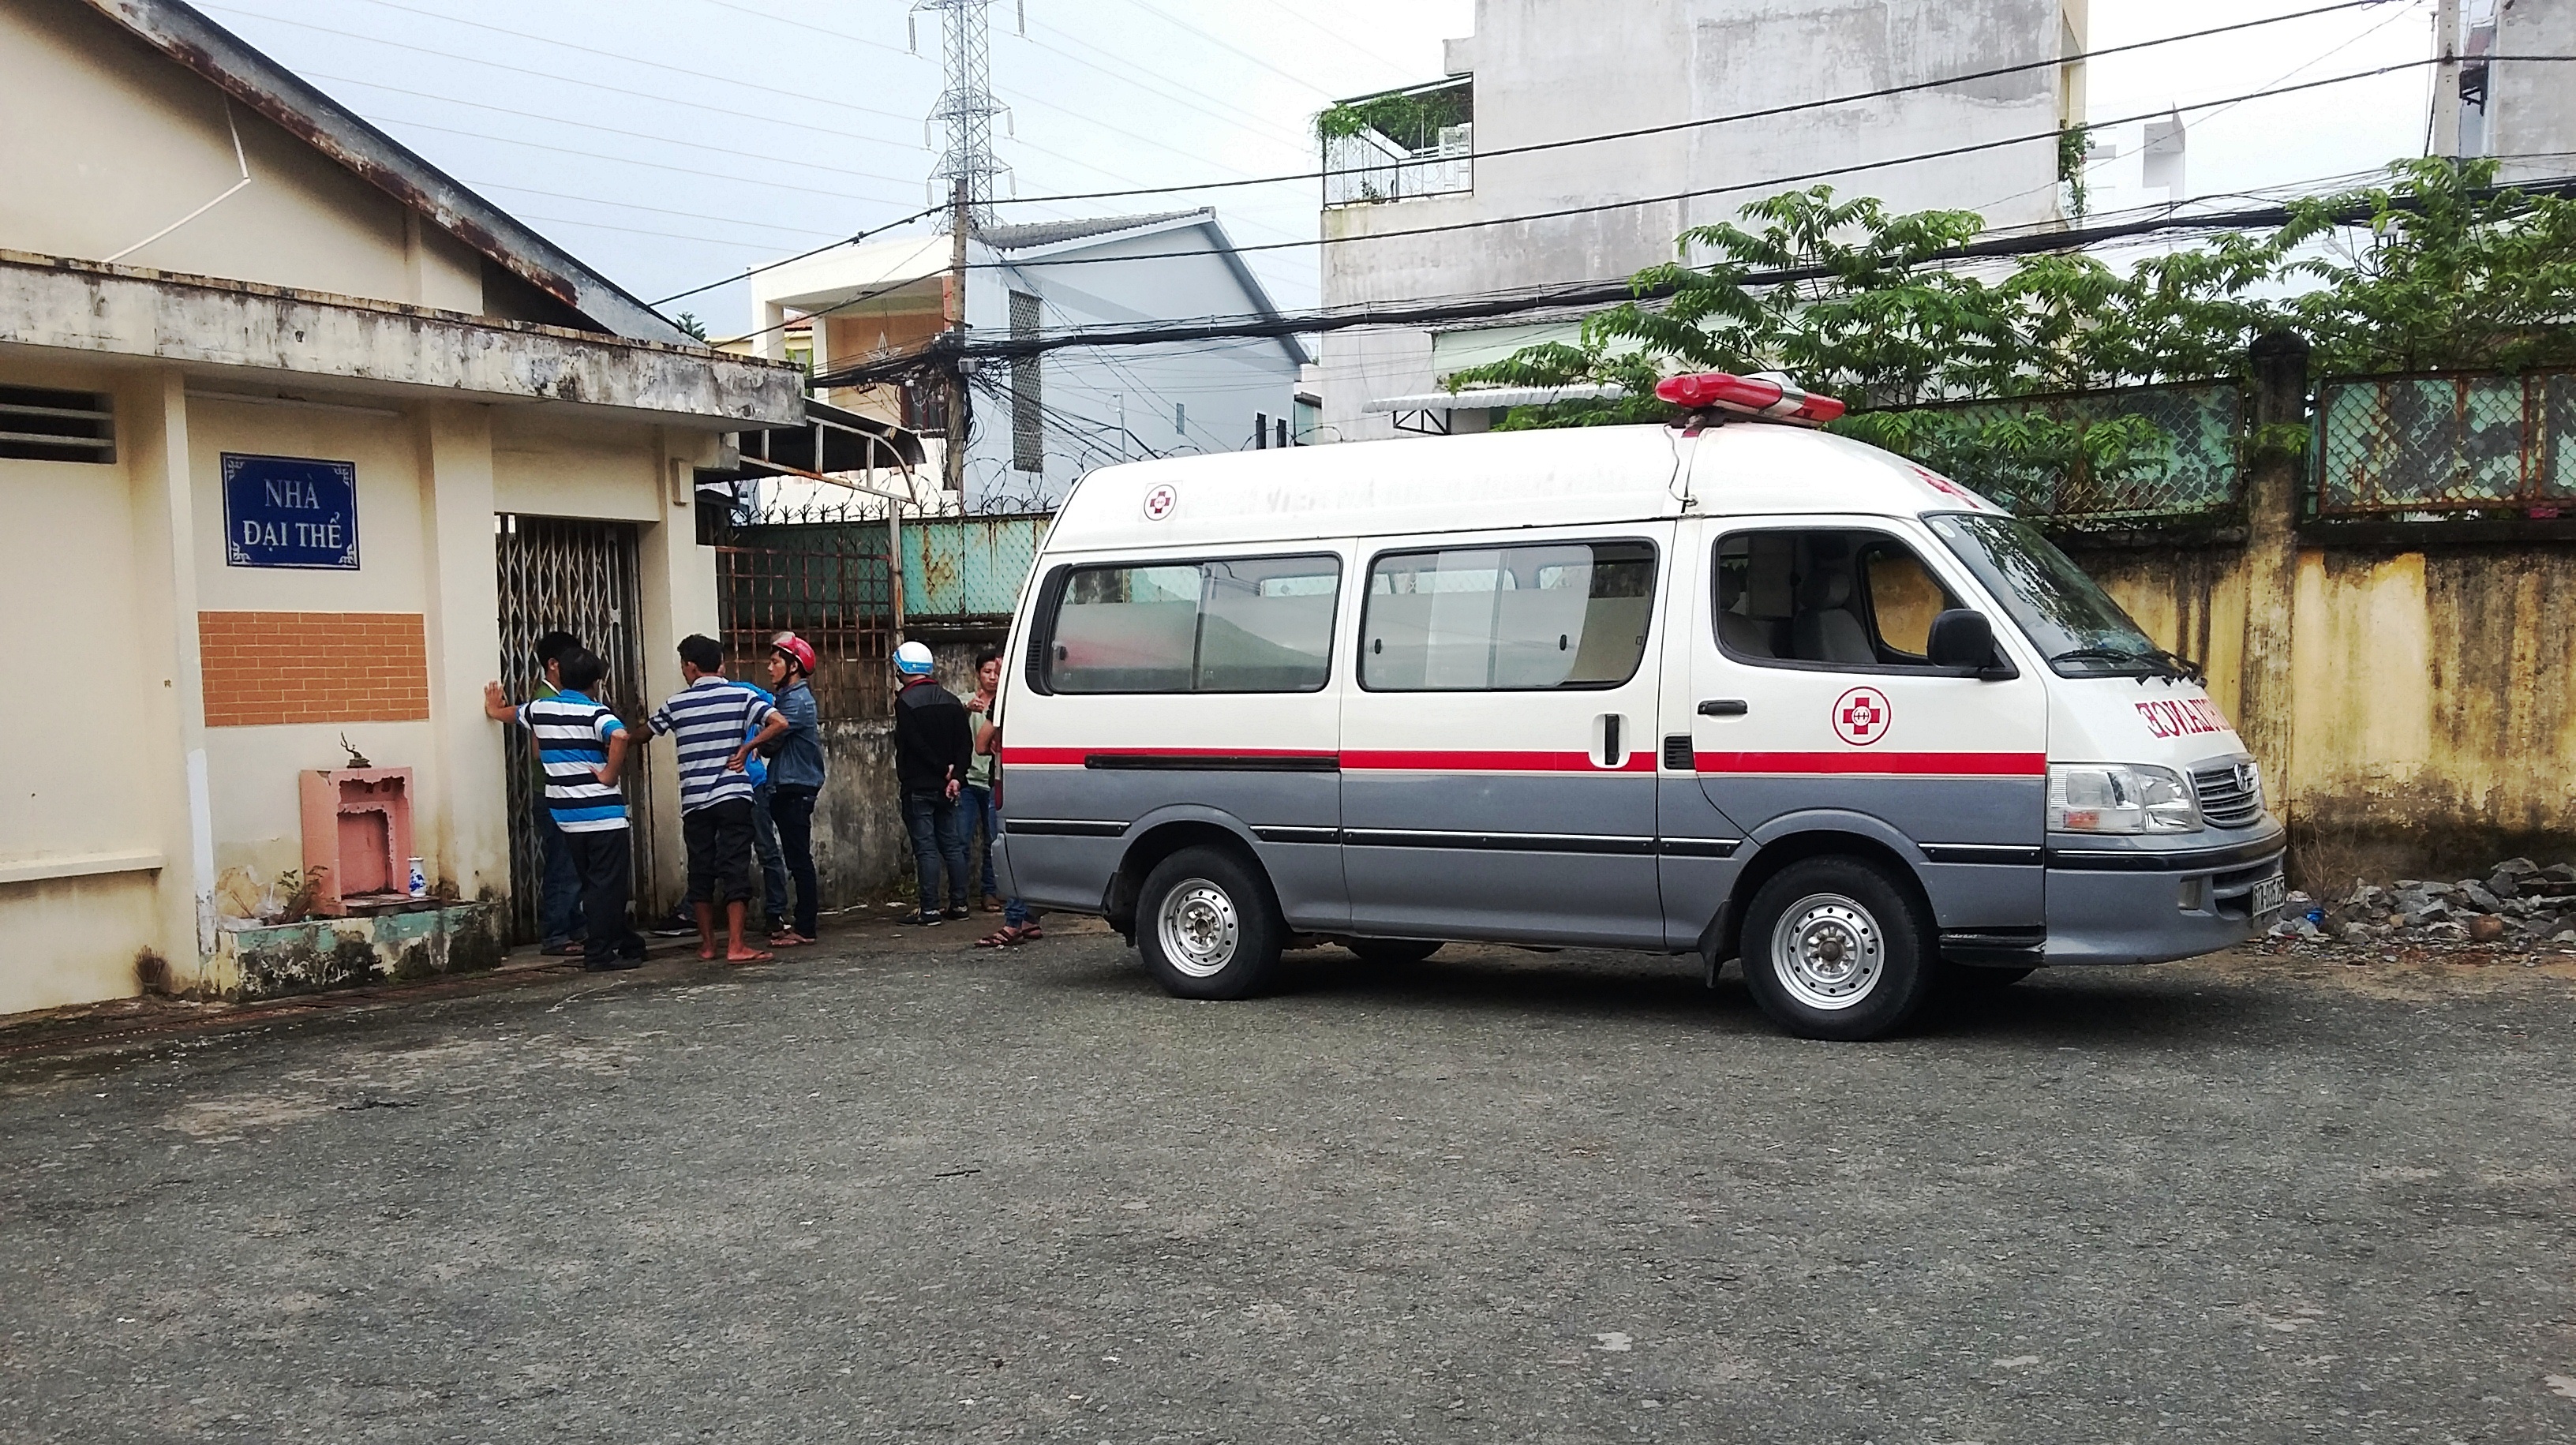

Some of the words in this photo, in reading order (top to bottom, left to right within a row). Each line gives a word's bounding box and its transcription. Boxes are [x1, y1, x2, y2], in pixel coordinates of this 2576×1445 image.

[264, 474, 320, 510] NHÀ
[242, 520, 288, 552] ĐẠI
[295, 511, 343, 548] THỂ
